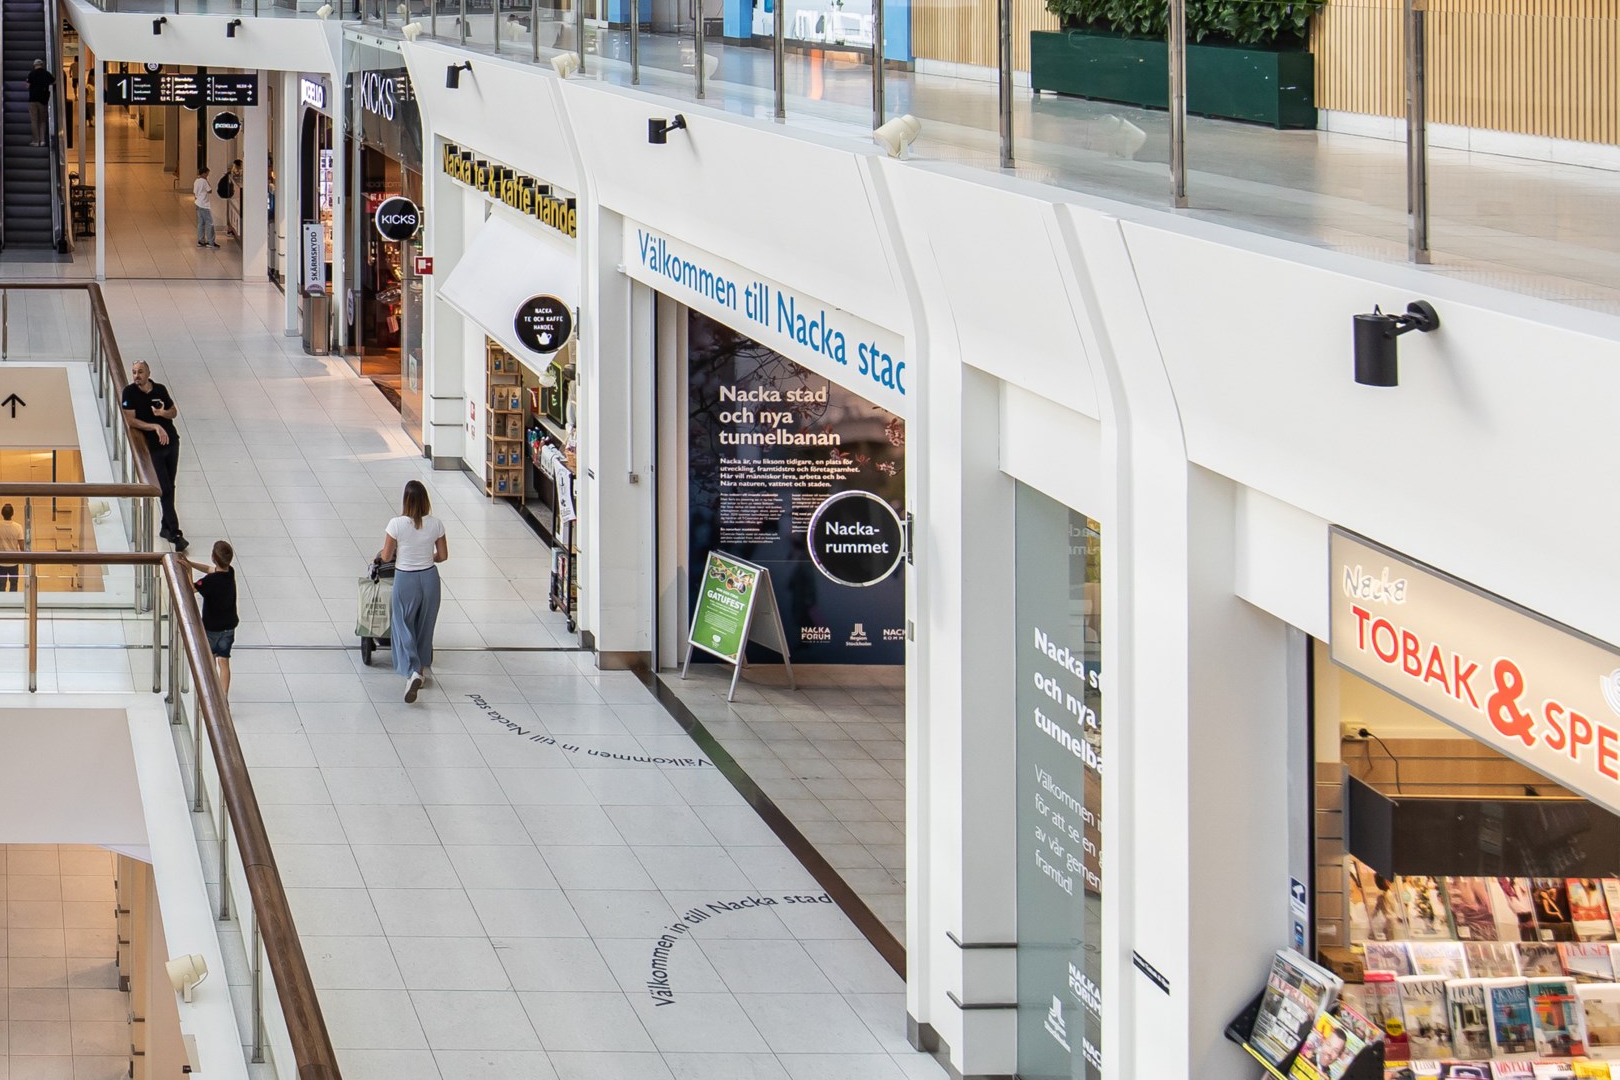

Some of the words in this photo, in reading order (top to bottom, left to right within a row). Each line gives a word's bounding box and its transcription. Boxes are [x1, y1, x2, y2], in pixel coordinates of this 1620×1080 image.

[116, 79, 127, 100] 1
[360, 70, 394, 121] KICKS
[443, 144, 471, 185] Nacka
[474, 161, 485, 192] te
[488, 165, 496, 197] &
[500, 169, 531, 215] kaffe
[381, 214, 416, 225] KICKS
[638, 229, 737, 311] Välkommen
[744, 282, 769, 327] till
[777, 290, 847, 366] Nacka
[719, 385, 782, 403] Nacka
[786, 385, 827, 403] stad
[719, 407, 754, 424] och
[760, 411, 794, 428] nya
[719, 429, 841, 446] tunnelbanan
[786, 458, 814, 466] tidigare,
[810, 466, 860, 474] företagsamhet.
[825, 521, 880, 536] Nacka-
[825, 542, 889, 554] rummet
[1343, 564, 1408, 605] Nacka
[707, 589, 745, 611] GATUFEST
[1034, 626, 1085, 681] Nacka
[464, 693, 491, 710] stad
[1034, 672, 1062, 704] och
[1066, 693, 1097, 729] nya
[1352, 605, 1480, 709] TOBAK
[1487, 659, 1535, 746] &
[1544, 701, 1619, 781] SPE
[487, 710, 530, 736] Nacka
[529, 734, 556, 746] till
[562, 743, 579, 752] in
[587, 748, 713, 767] Välkommen
[1034, 763, 1095, 827] Välkommen
[1034, 793, 1050, 817] för
[1051, 811, 1066, 833] att
[1067, 824, 1080, 844] se
[1082, 836, 1096, 858] en
[1035, 825, 1046, 844] av
[1048, 836, 1064, 858] vår
[1035, 849, 1073, 896] framtid!
[646, 934, 678, 1007] Välkommen
[664, 922, 690, 935] in
[684, 907, 712, 924] till
[706, 896, 779, 914] Nacka
[783, 893, 834, 904] stad
